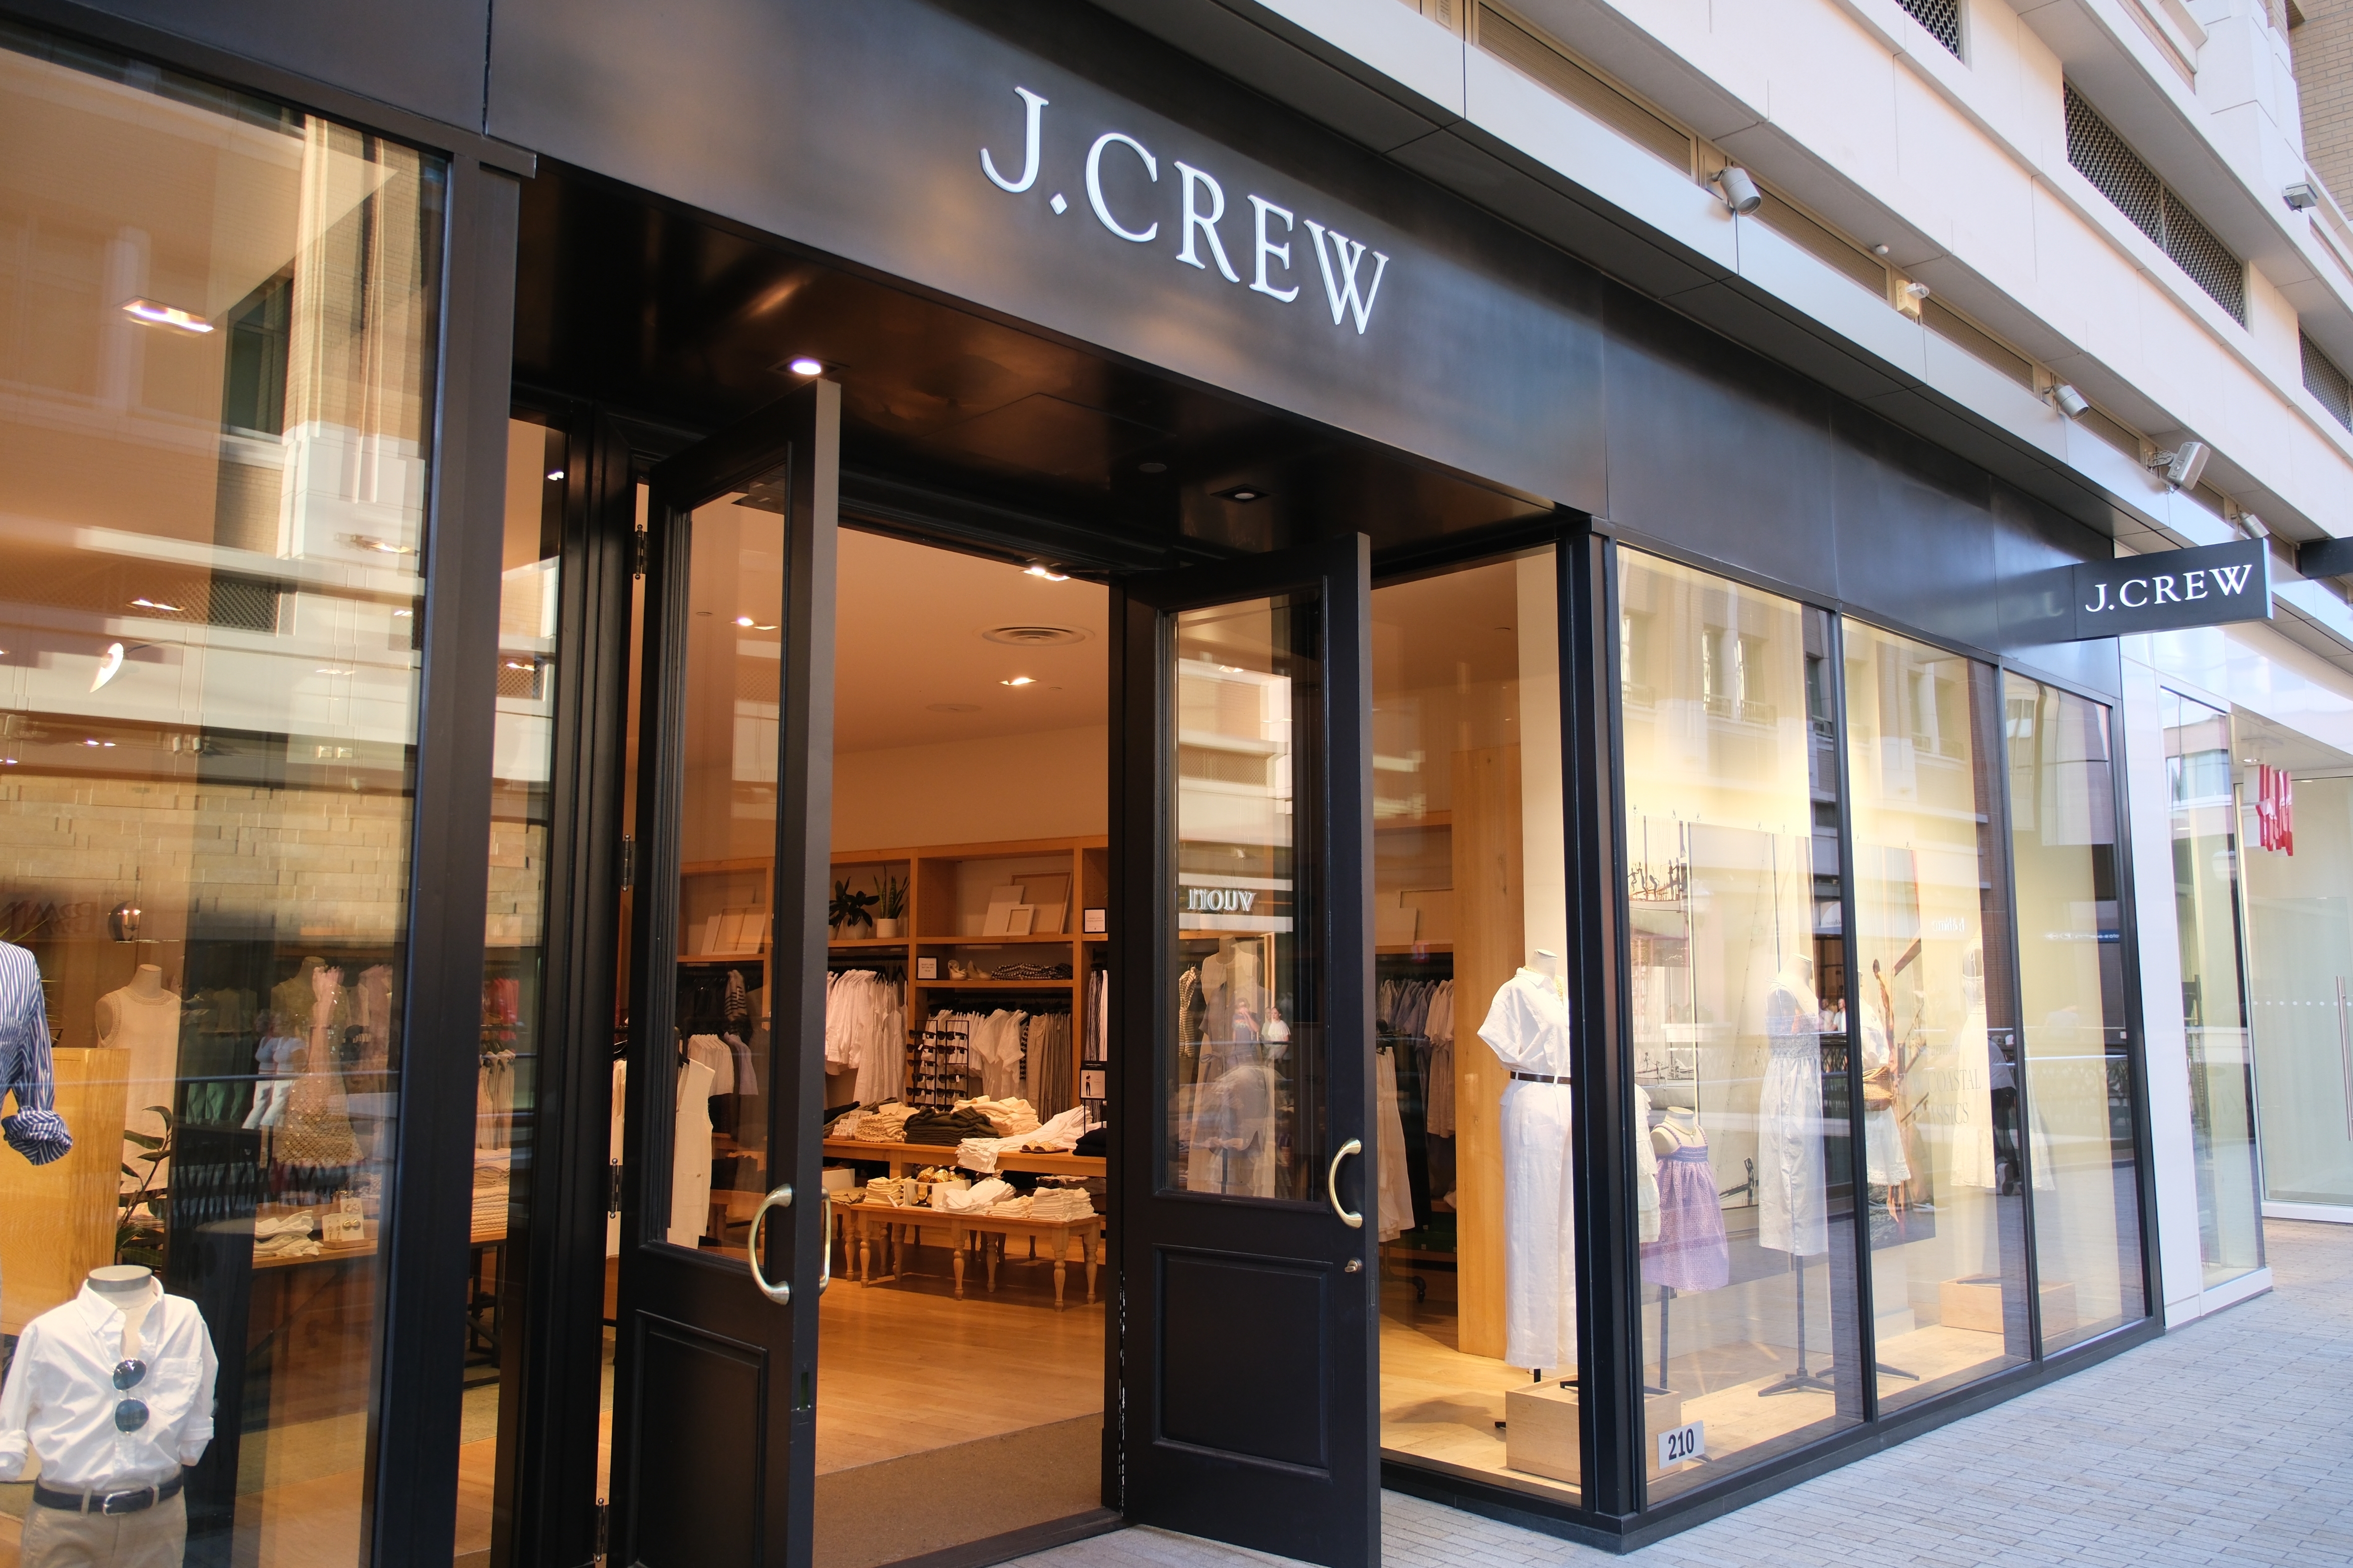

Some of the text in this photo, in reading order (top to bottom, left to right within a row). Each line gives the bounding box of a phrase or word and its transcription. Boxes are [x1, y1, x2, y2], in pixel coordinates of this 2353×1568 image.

[980, 86, 1389, 334] J.CREW
[2085, 564, 2252, 612] J.CREW
[1928, 1069, 1982, 1093] COASTAL
[1668, 1428, 1694, 1461] 210
